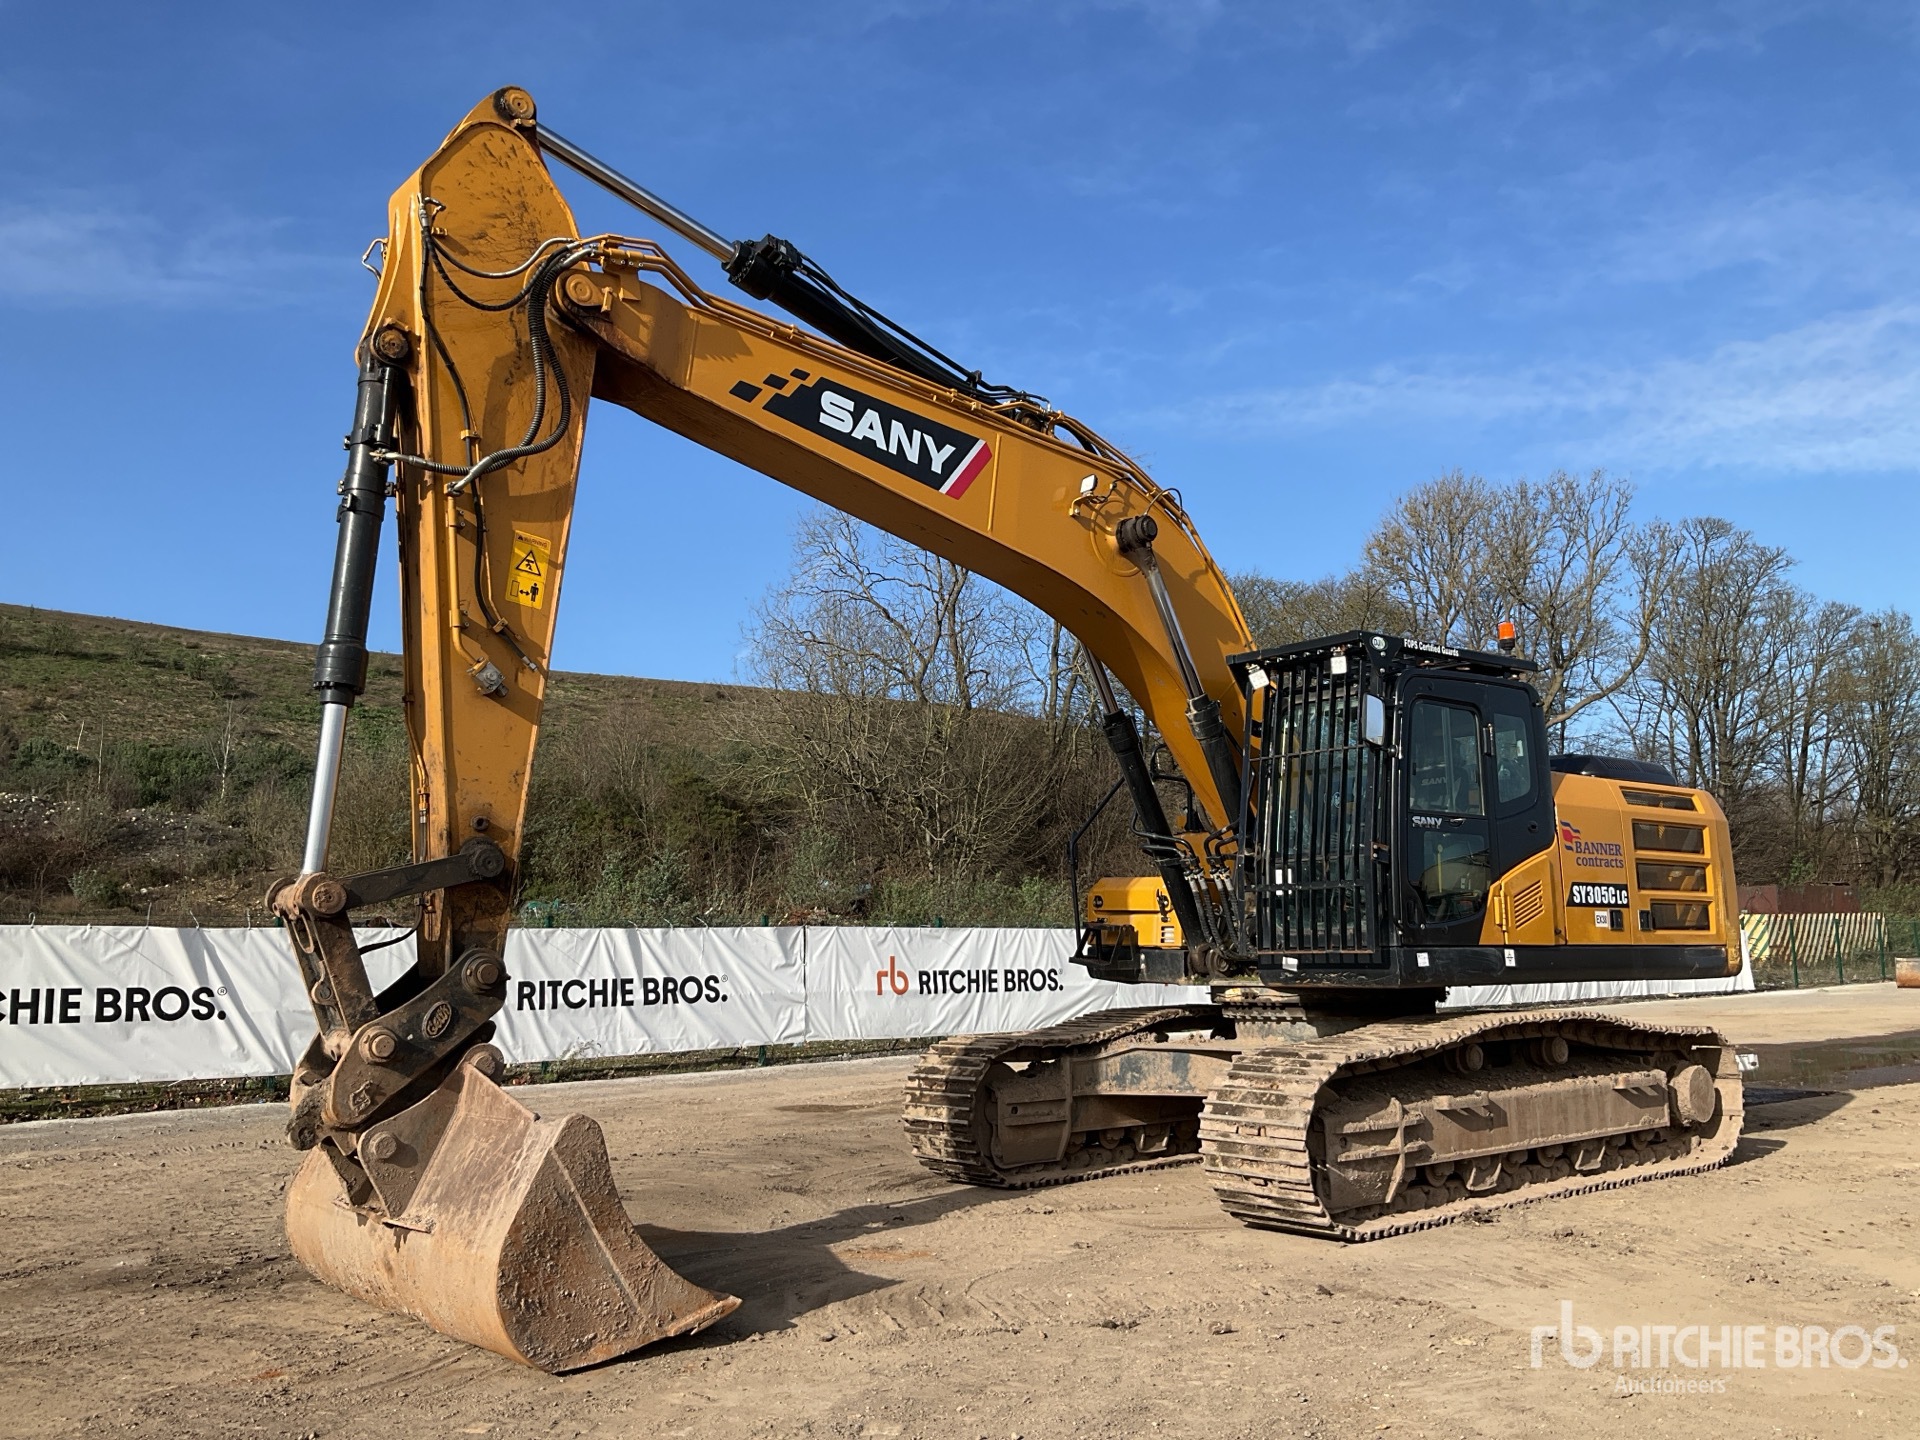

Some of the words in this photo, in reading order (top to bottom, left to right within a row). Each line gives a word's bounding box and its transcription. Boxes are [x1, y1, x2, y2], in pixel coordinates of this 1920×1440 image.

[819, 390, 956, 475] SANY
[1403, 638, 1419, 650] FOPS
[1419, 641, 1441, 654] Certified
[1441, 645, 1460, 657] Guards
[1421, 776, 1447, 786] SANY
[1412, 815, 1443, 826] SANY
[1574, 840, 1623, 857] BANNER
[1575, 855, 1624, 869] contracts
[918, 968, 999, 995] RITCHIE
[517, 977, 634, 1011] RITCHIE
[0, 987, 83, 1025] HIE
